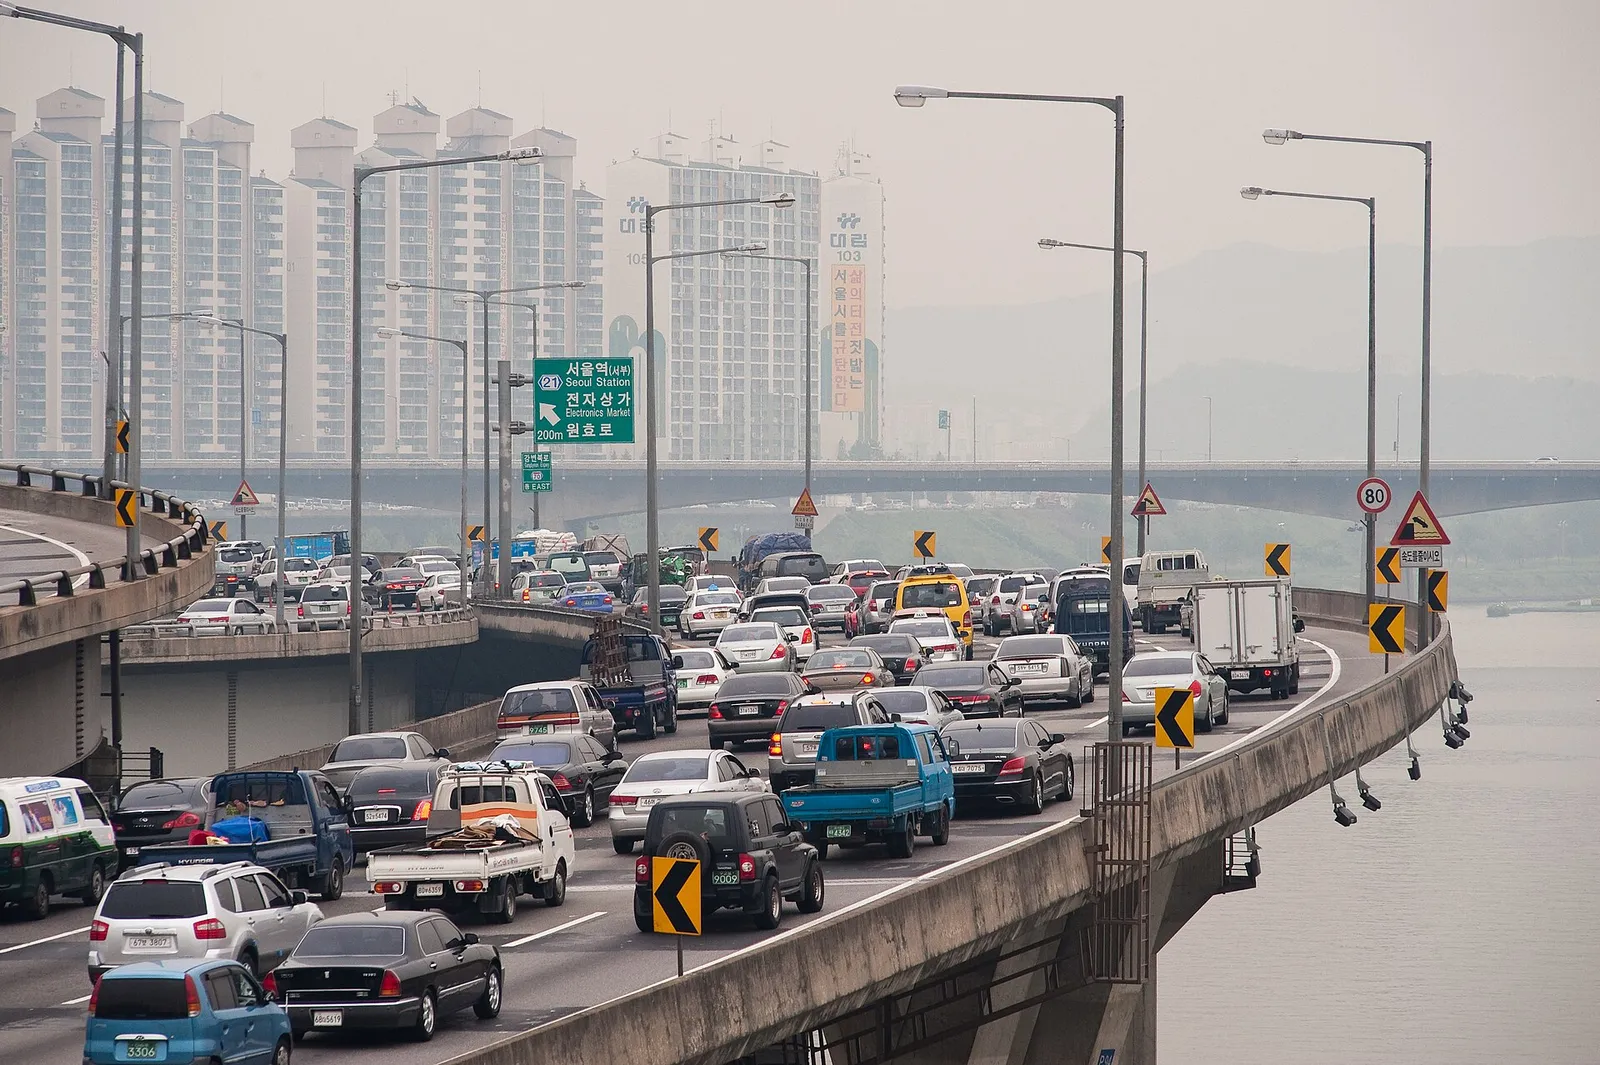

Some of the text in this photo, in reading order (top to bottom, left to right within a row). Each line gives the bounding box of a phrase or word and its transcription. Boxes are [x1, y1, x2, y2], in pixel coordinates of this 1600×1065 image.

[830, 233, 867, 248] 대림
[837, 250, 861, 261] 103
[566, 362, 631, 376] 서울역(서부)
[543, 377, 559, 388] 21
[566, 377, 631, 387] Seoul Station
[566, 392, 631, 407] 전자상가
[566, 408, 631, 417] Electronics Market
[537, 430, 563, 440] 200m
[566, 423, 614, 438] 원효로
[524, 454, 550, 462] 강변북로
[1365, 489, 1384, 504] 80
[714, 875, 737, 884] 9009
[127, 1047, 155, 1057] 3306
